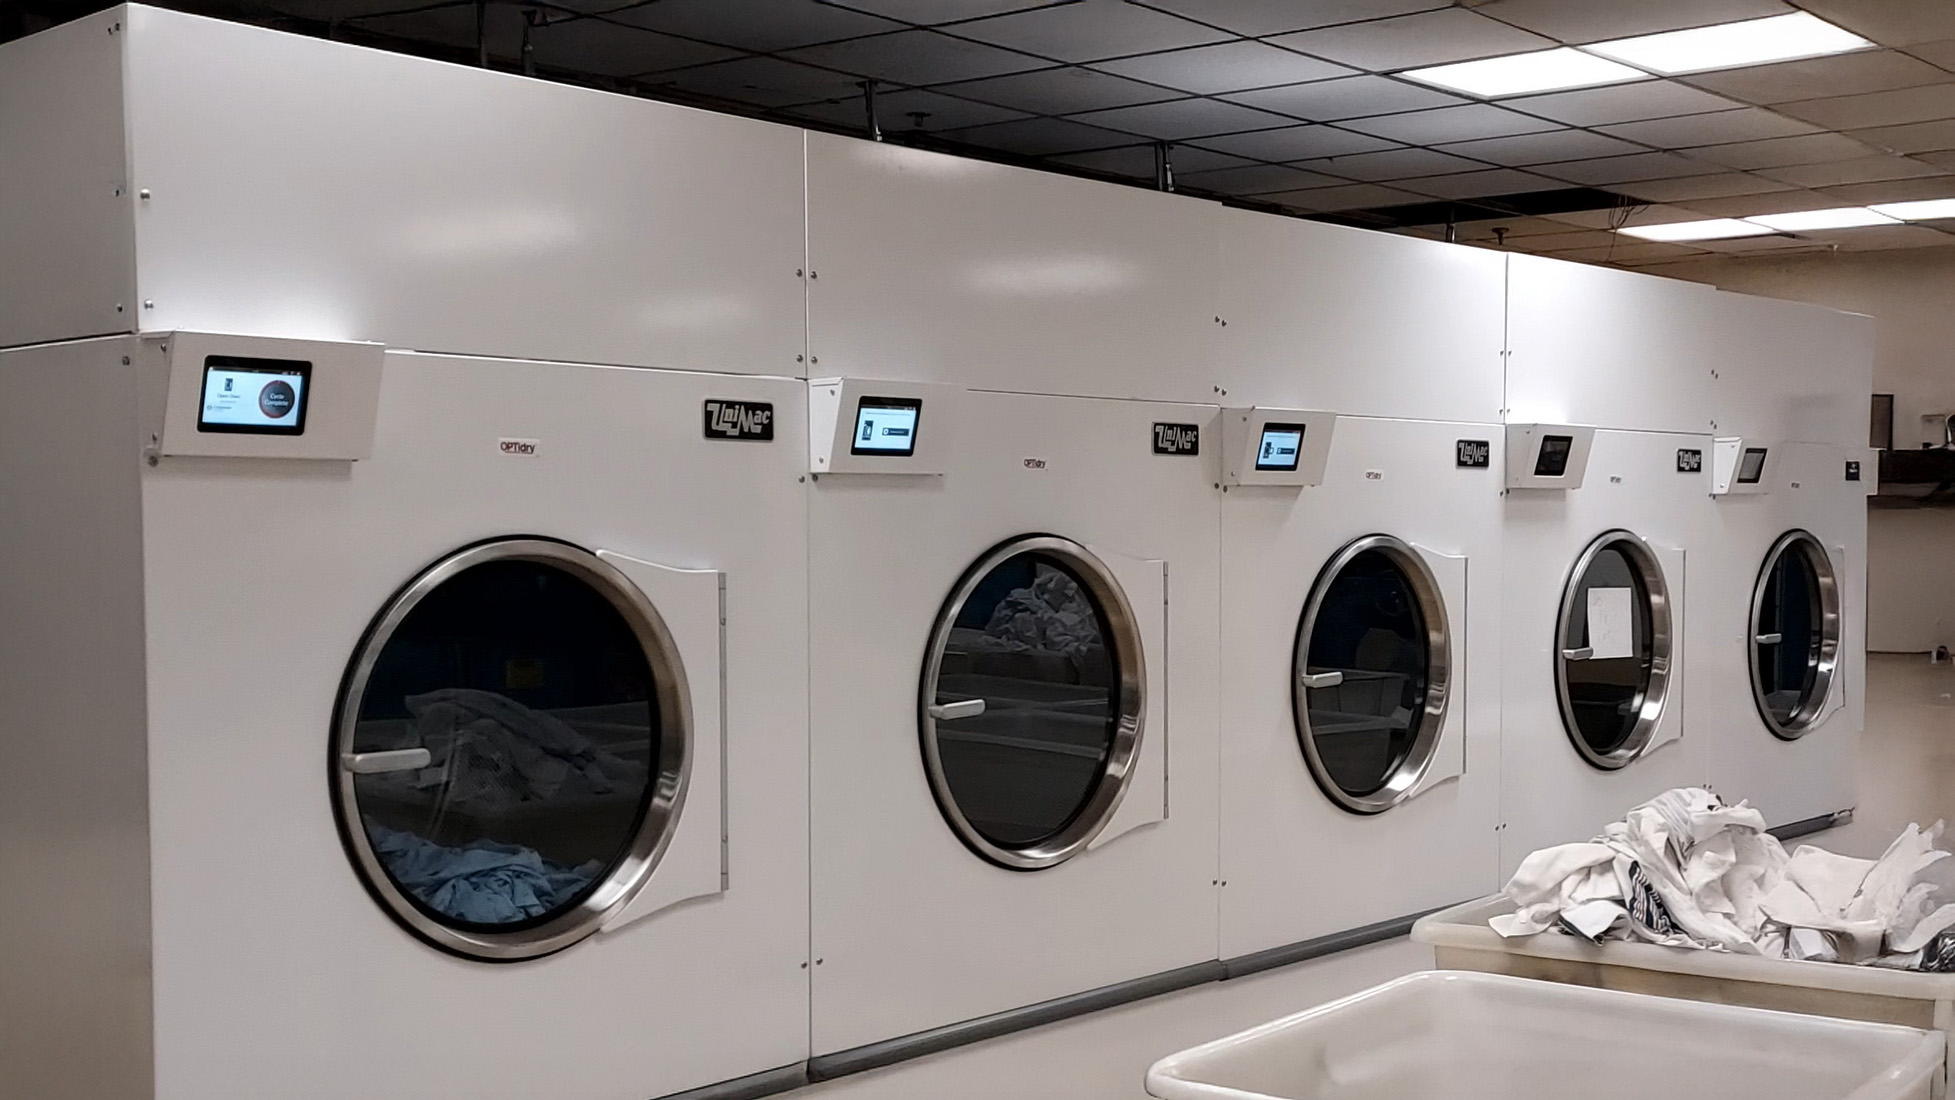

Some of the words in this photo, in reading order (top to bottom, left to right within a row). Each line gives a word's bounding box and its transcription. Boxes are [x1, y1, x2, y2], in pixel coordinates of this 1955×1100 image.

[706, 402, 771, 436] UniMac
[500, 441, 536, 455] OPTidry
[1155, 425, 1197, 452] UniMac
